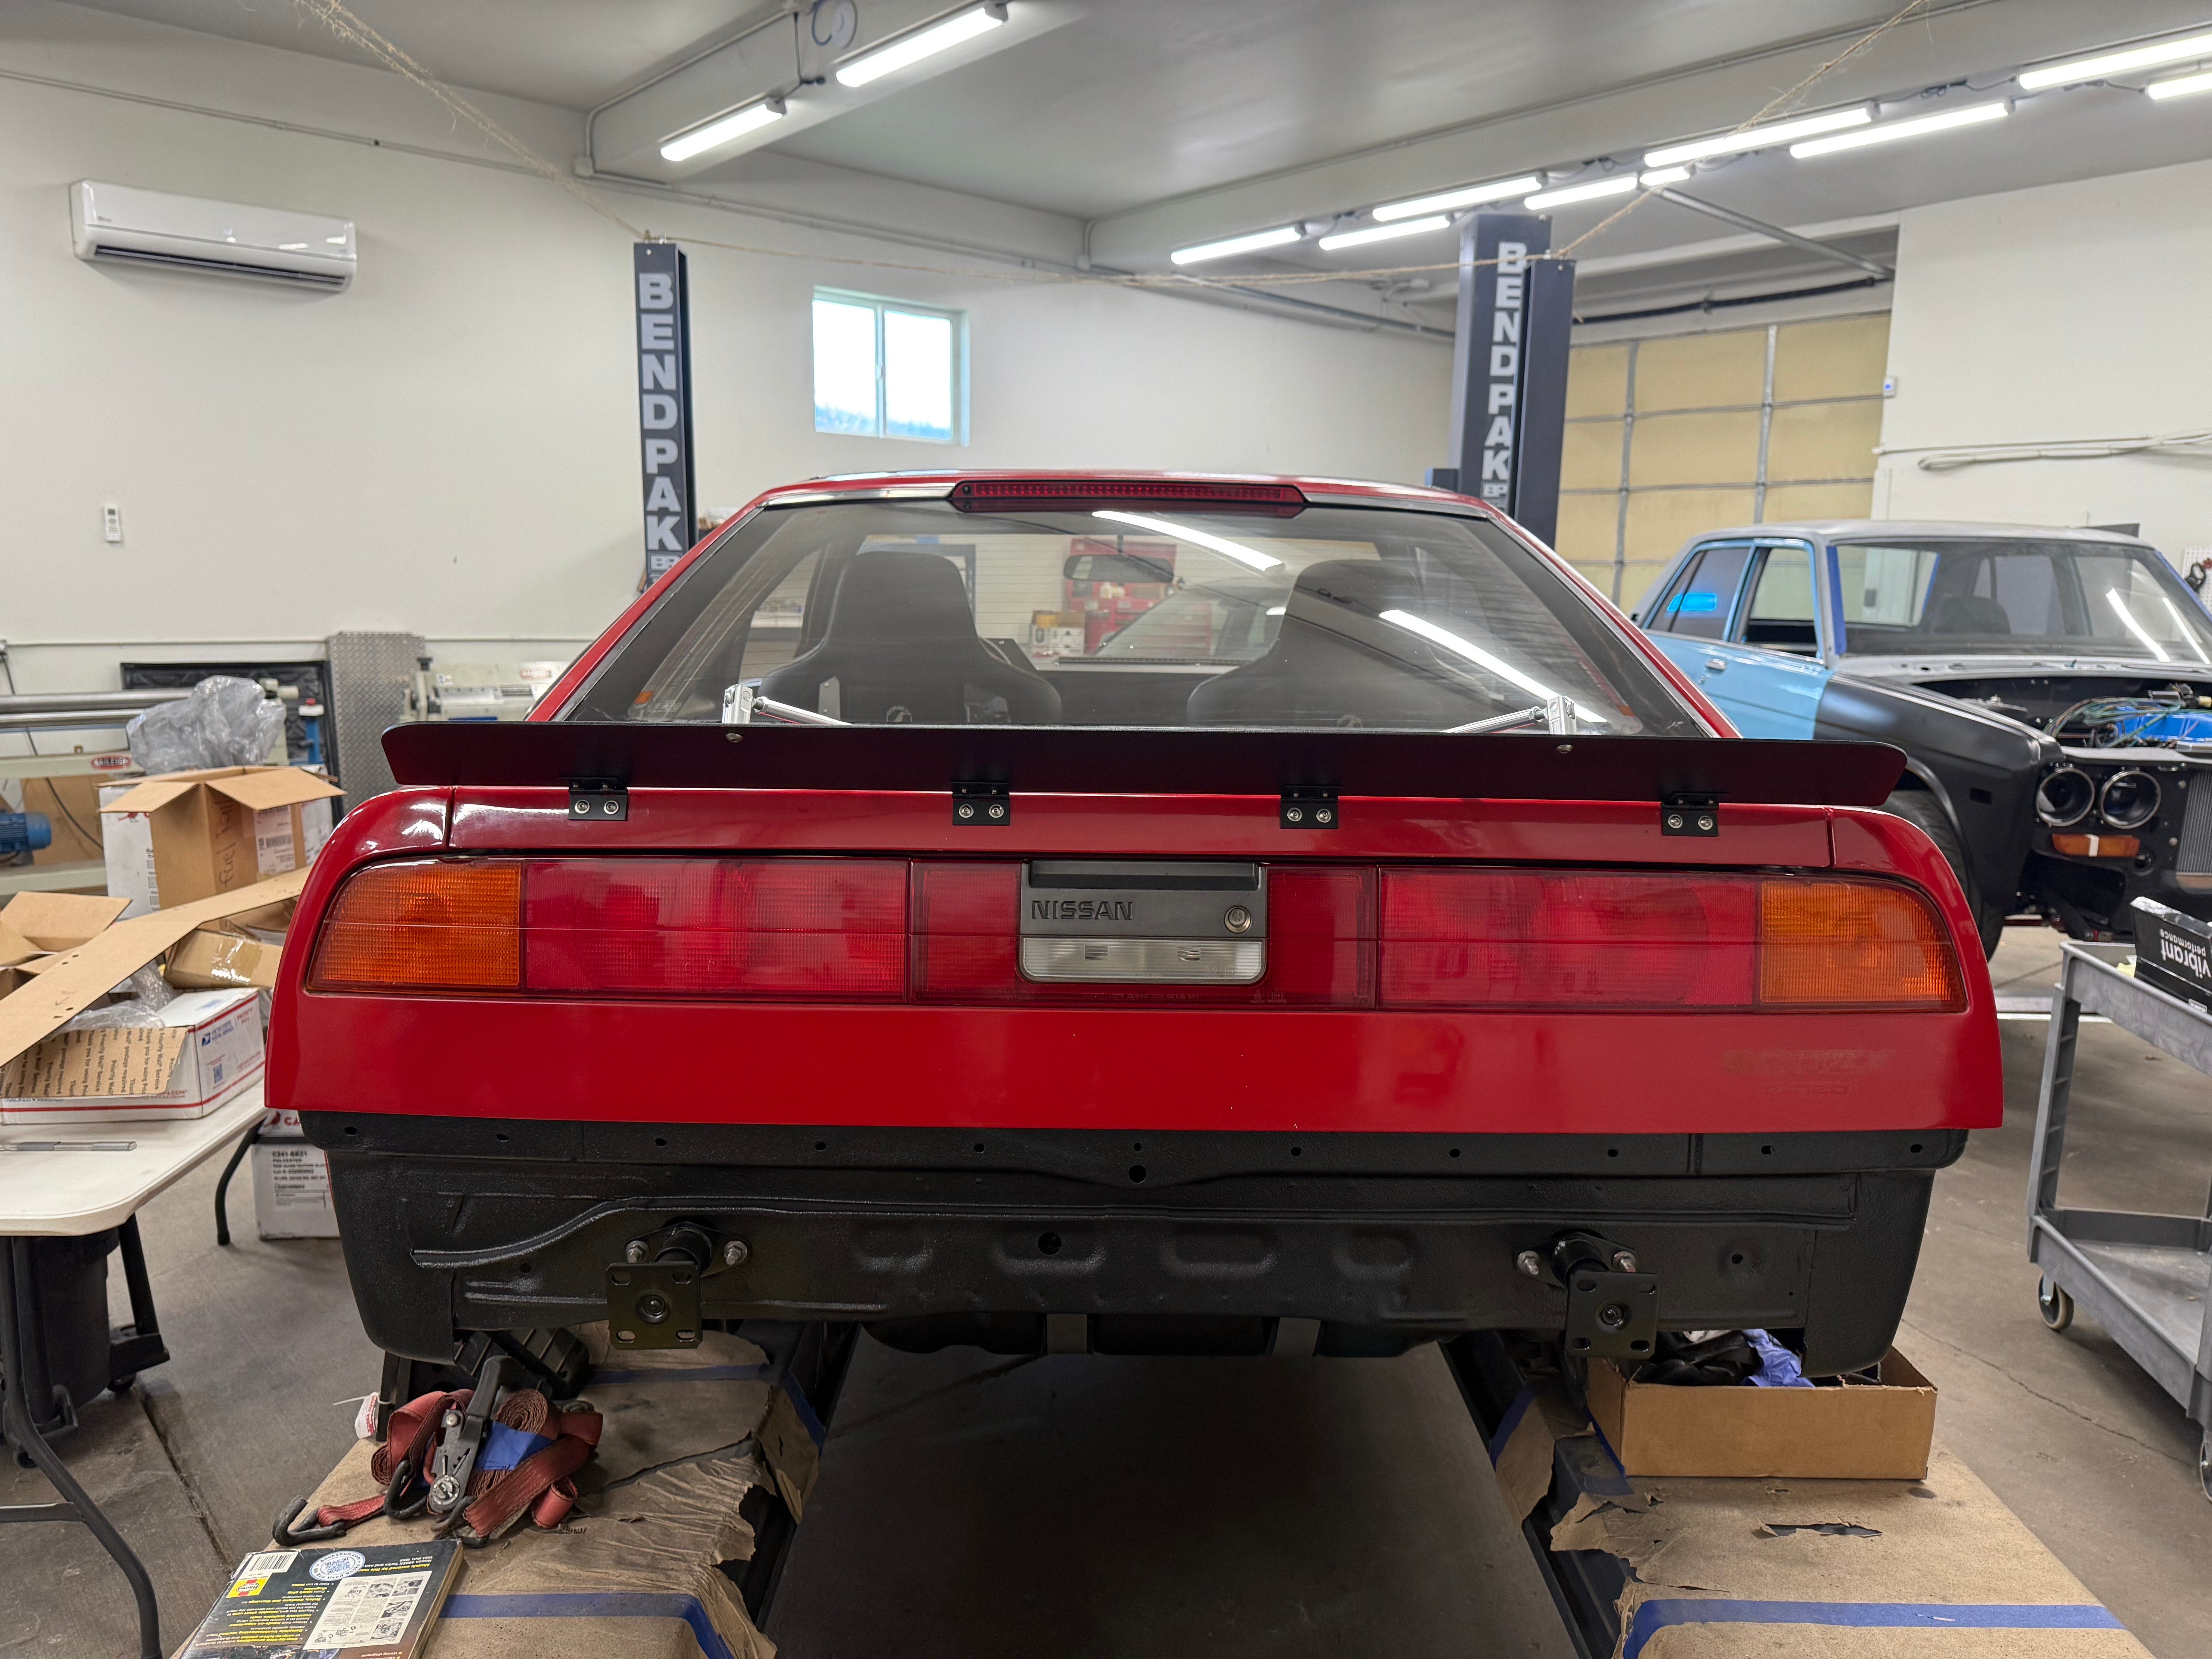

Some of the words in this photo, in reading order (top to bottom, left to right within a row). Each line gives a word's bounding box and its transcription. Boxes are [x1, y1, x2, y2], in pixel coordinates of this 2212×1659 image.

[1481, 241, 1527, 481] BENDPAK
[639, 272, 682, 552] BENDPAK
[1032, 900, 1133, 920] NISSAN
[2160, 929, 2207, 957] performance
[2161, 938, 2212, 979] vibrant
